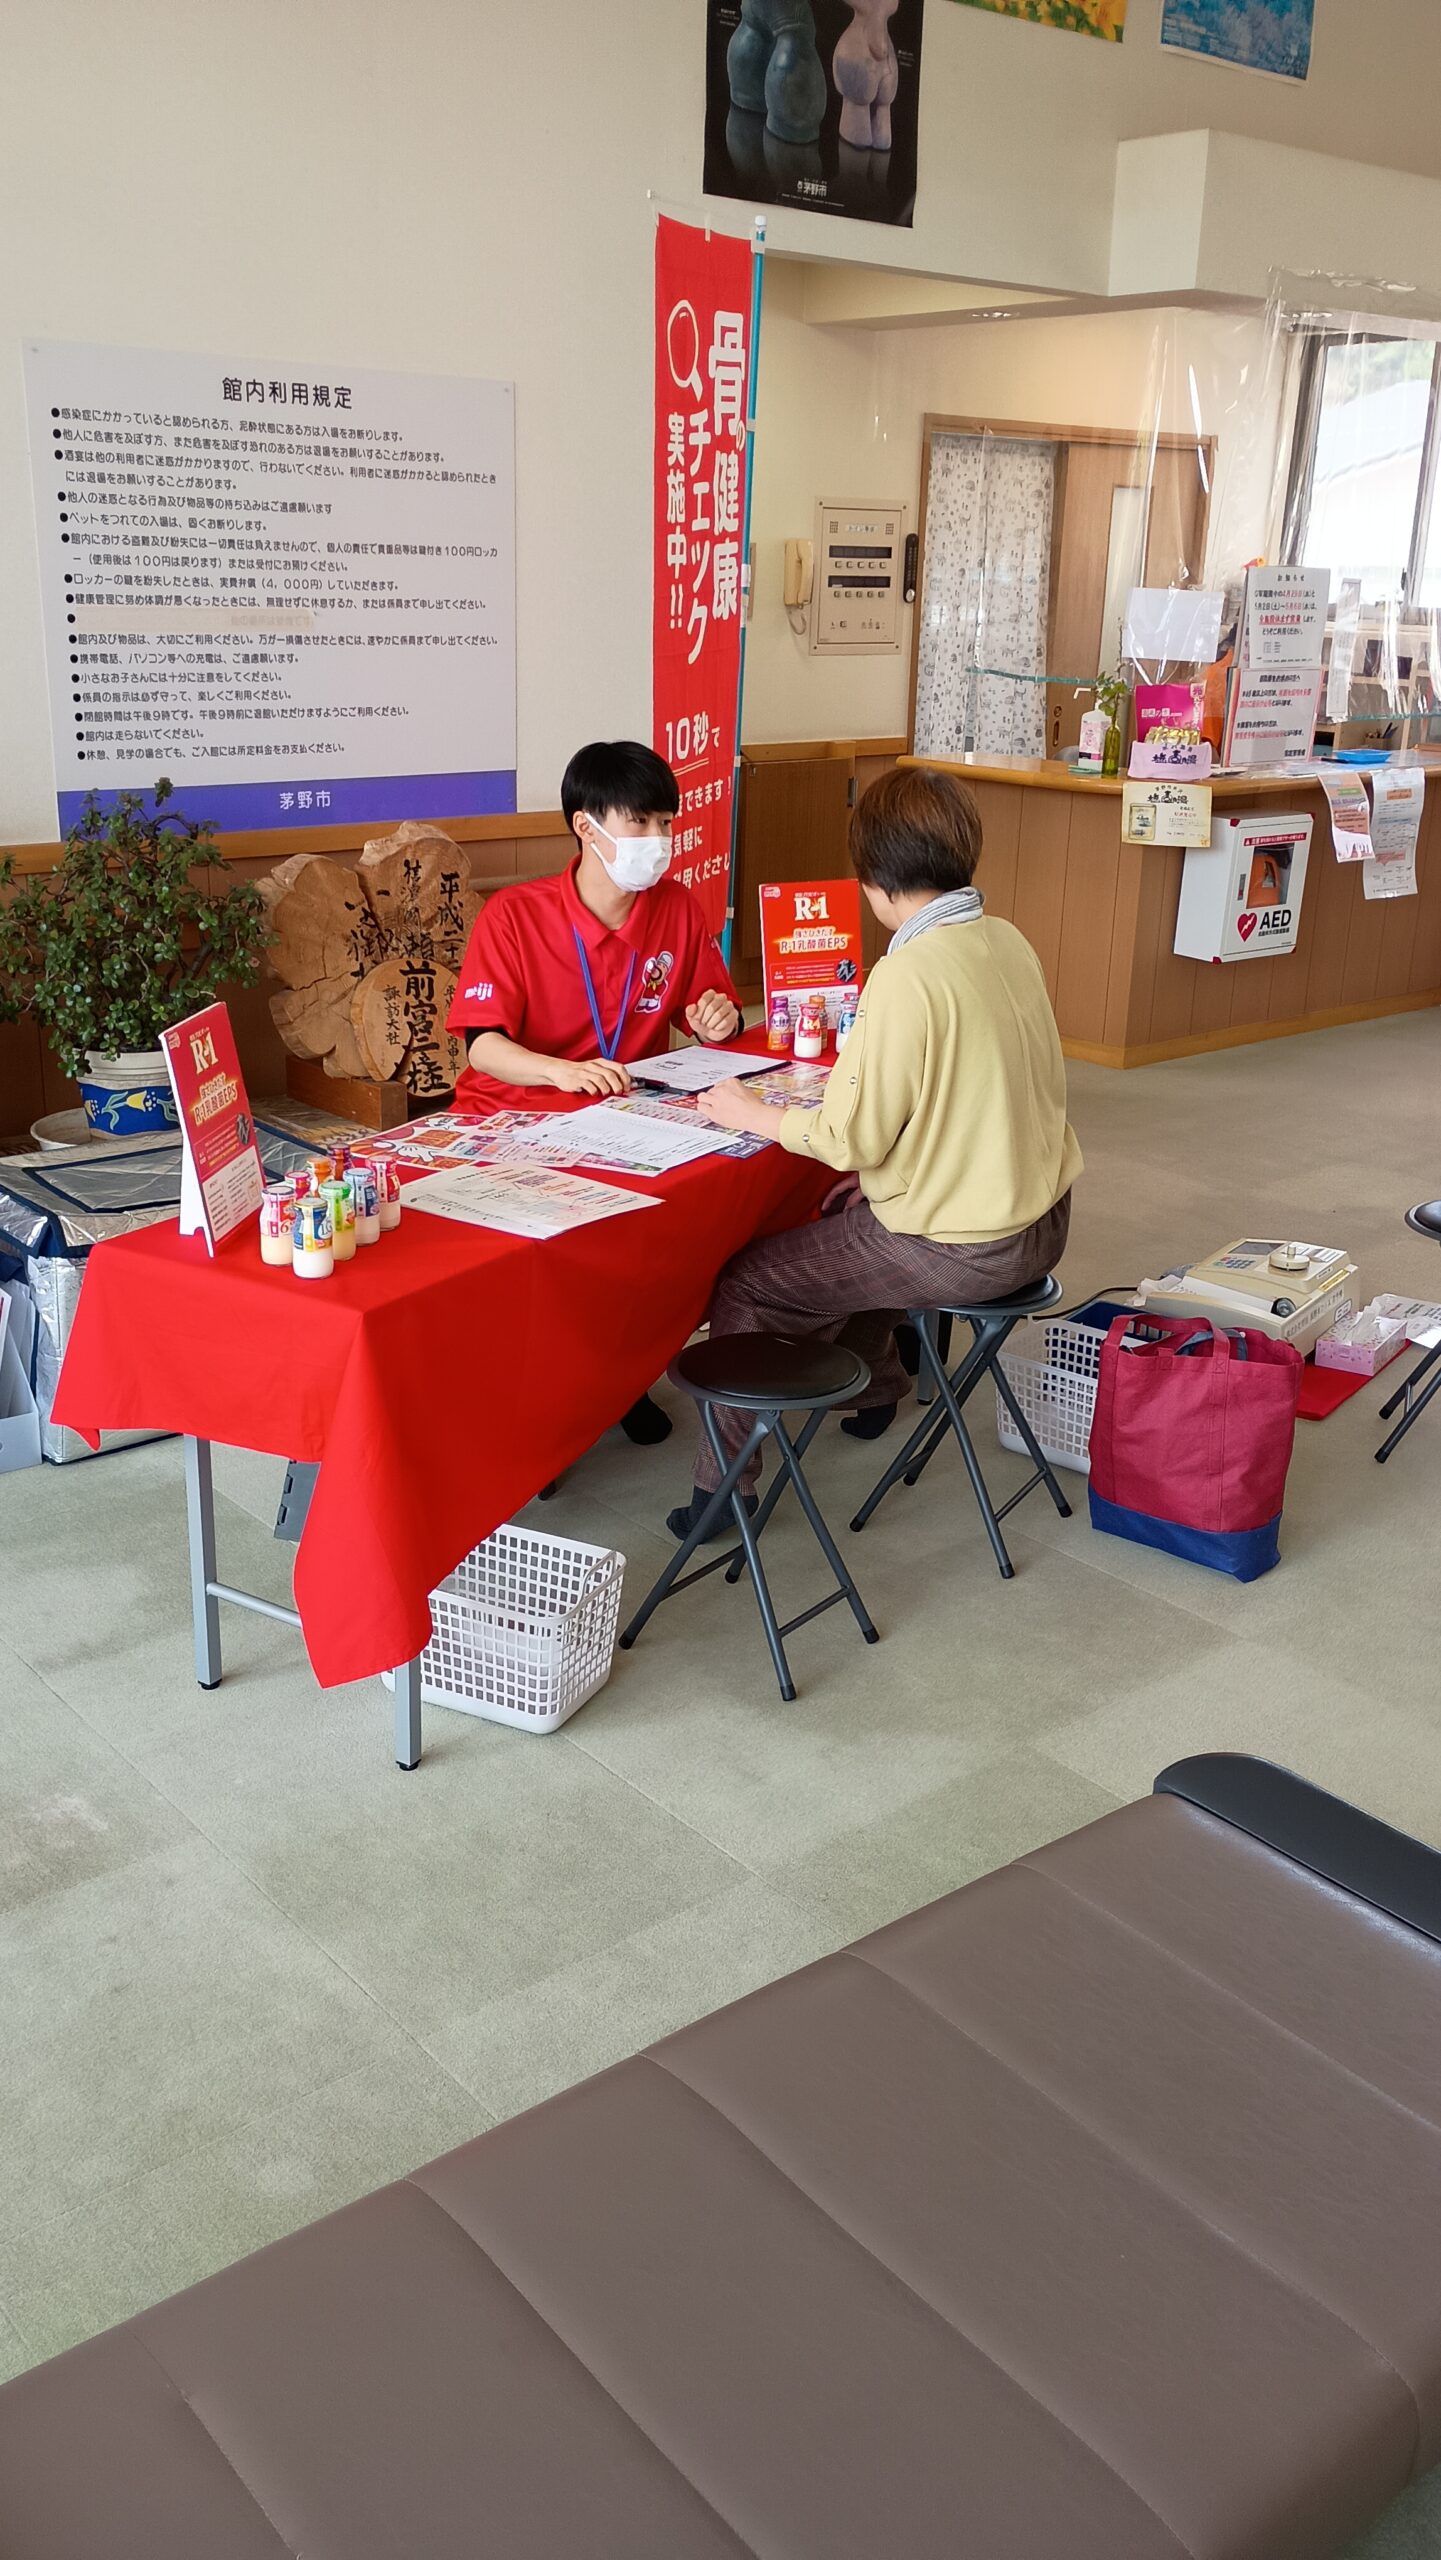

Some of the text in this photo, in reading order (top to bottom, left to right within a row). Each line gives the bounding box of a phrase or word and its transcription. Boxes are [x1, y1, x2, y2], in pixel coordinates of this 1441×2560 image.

[223, 378, 353, 409] 館内利用規定
[707, 310, 746, 622] 骨の健康
[66, 471, 238, 490] には退場をお願いすることがあります。
[70, 514, 268, 531] ペットをつれての入場は、固くお断りします。
[687, 408, 712, 665] チェック
[80, 653, 298, 664] 携帯電話、パソコン等への充電は、ご遠慮願います。
[81, 672, 282, 683] 小さなお子さんには十分に注意をしてください。
[82, 690, 292, 703] 係員の指示は必ず守って、楽しくご利用ください。
[86, 730, 205, 742] 館内は走らないでください。
[664, 709, 721, 764] 10秒で
[279, 790, 332, 809] 茅野市
[1259, 909, 1292, 930] AED
[780, 938, 847, 952] R-1乳酸菌EPS
[464, 982, 493, 1001] meiji
[382, 984, 402, 1046] 諏訪大社
